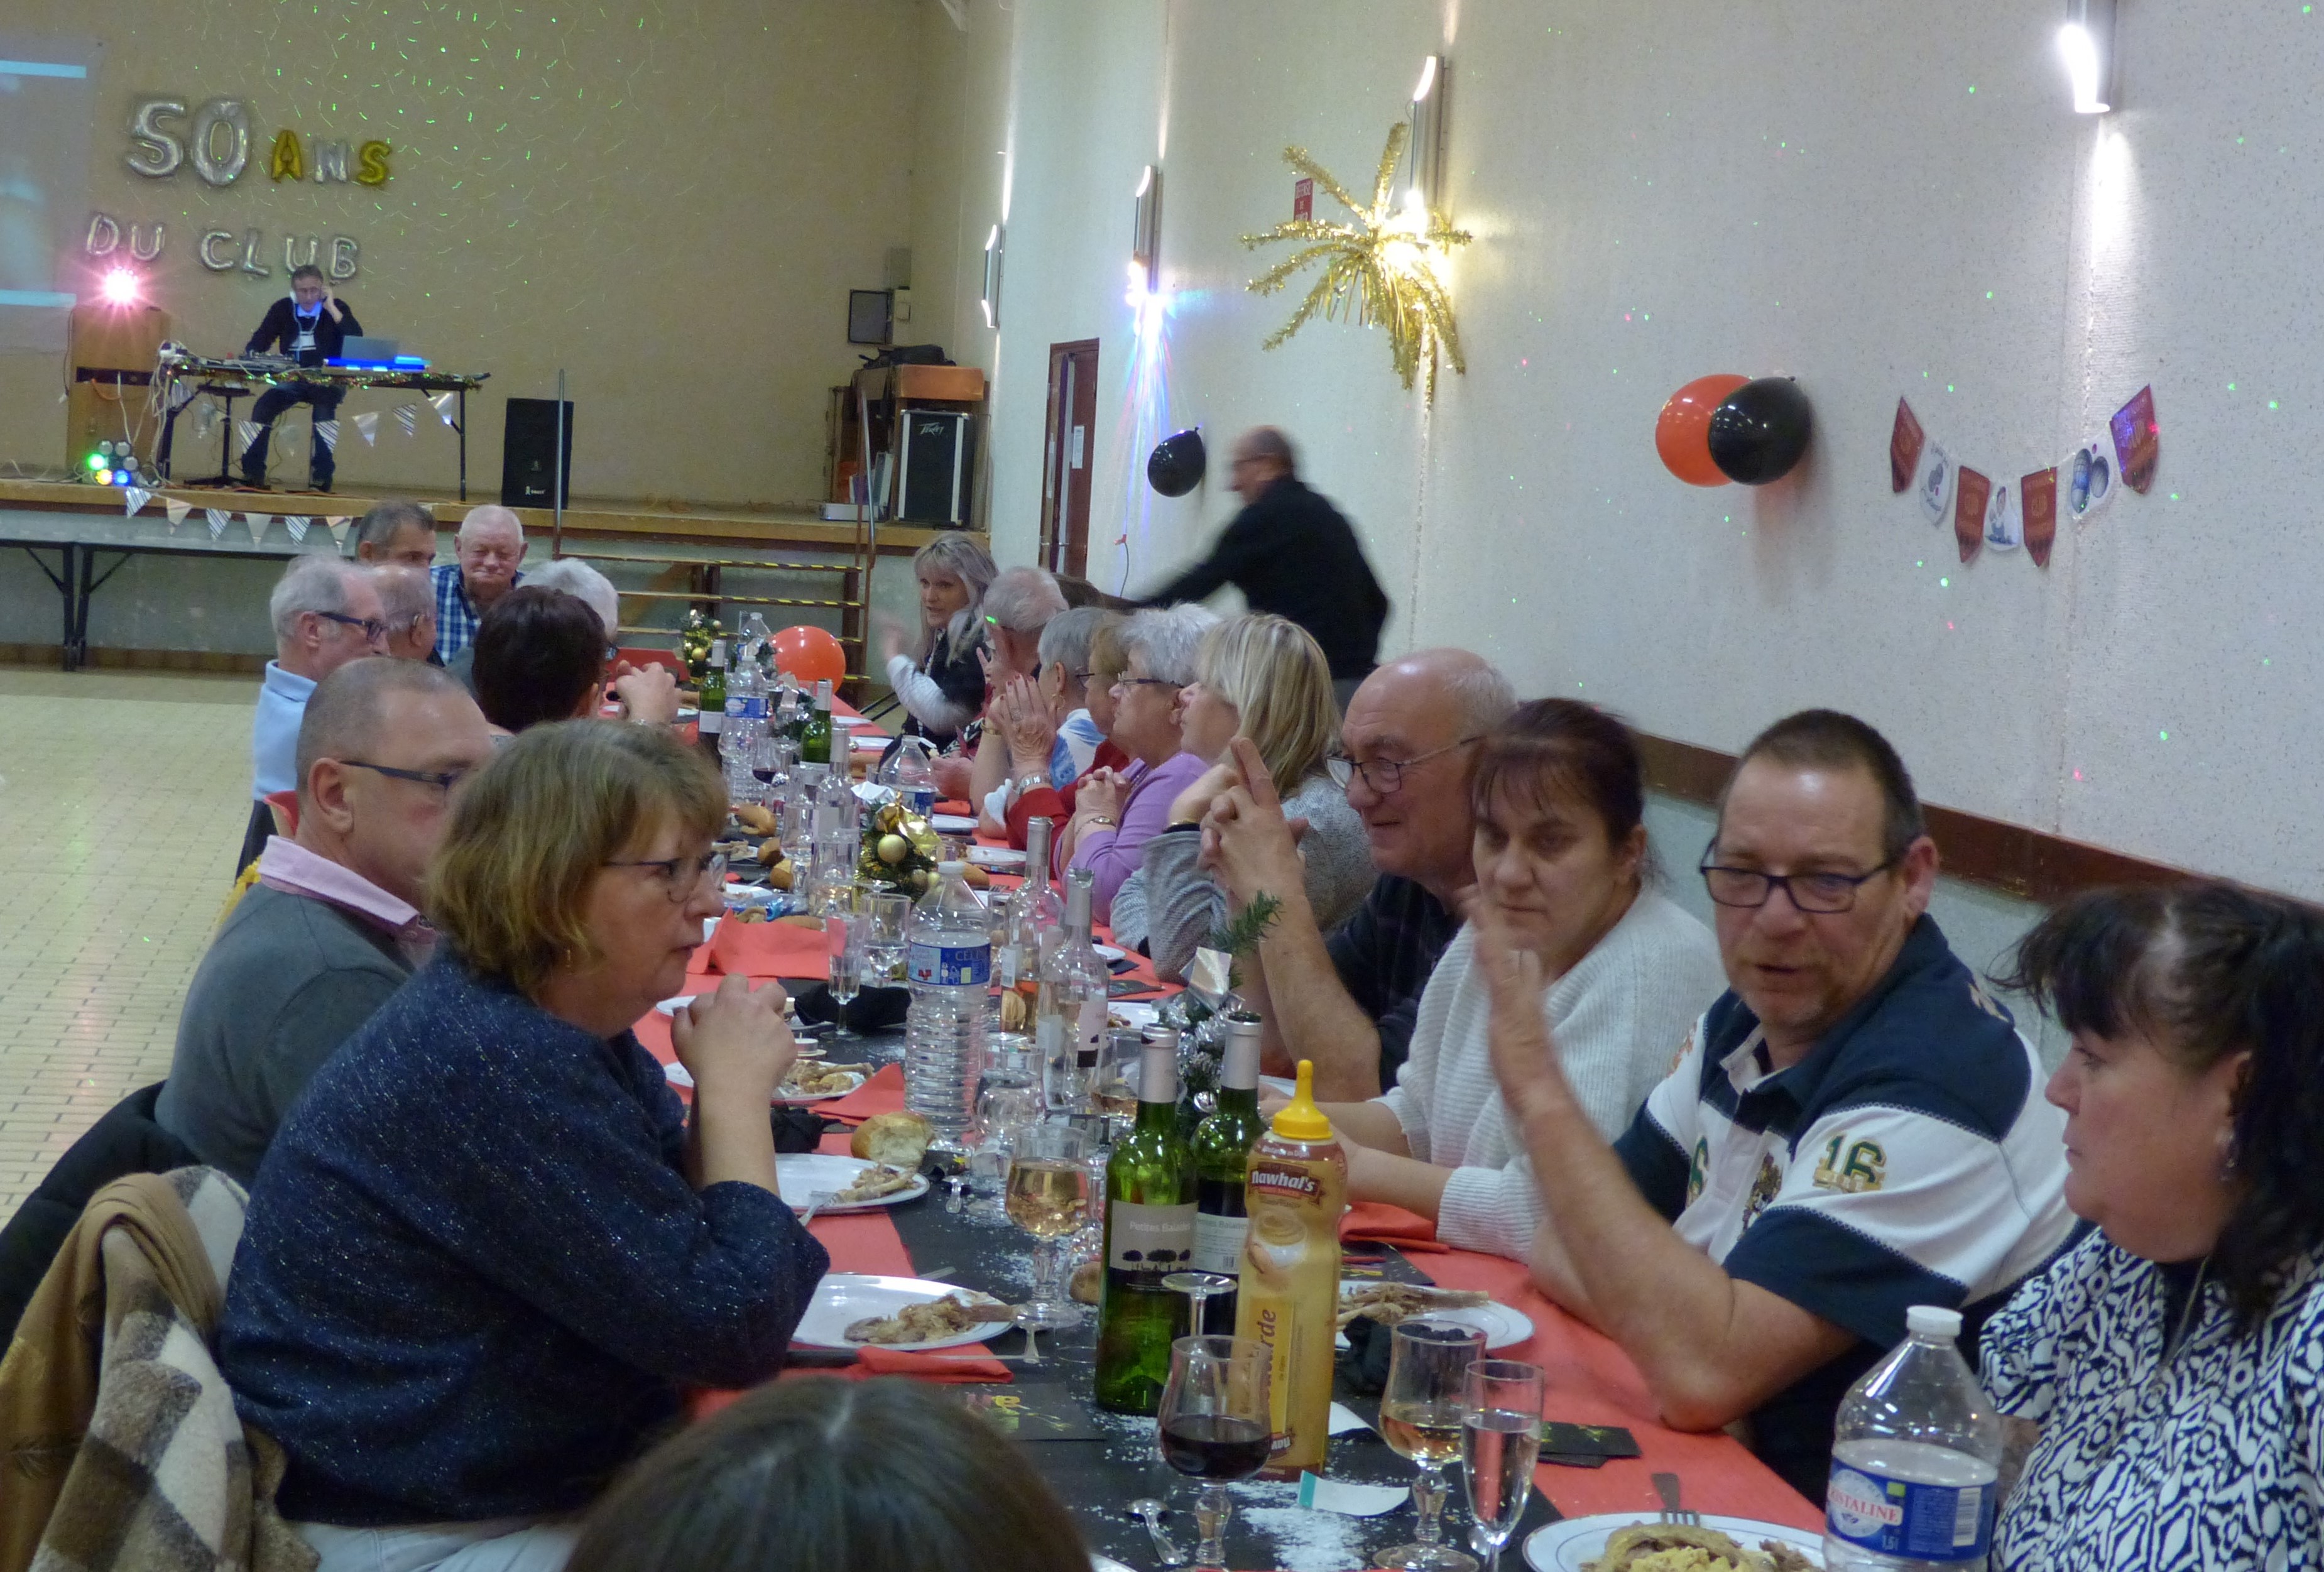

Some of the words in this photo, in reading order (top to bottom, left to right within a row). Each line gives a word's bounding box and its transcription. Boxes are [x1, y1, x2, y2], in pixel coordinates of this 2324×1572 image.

[126, 98, 251, 186] 50
[271, 128, 392, 185] ANS
[87, 212, 164, 261] DU
[199, 229, 359, 280] CLUB
